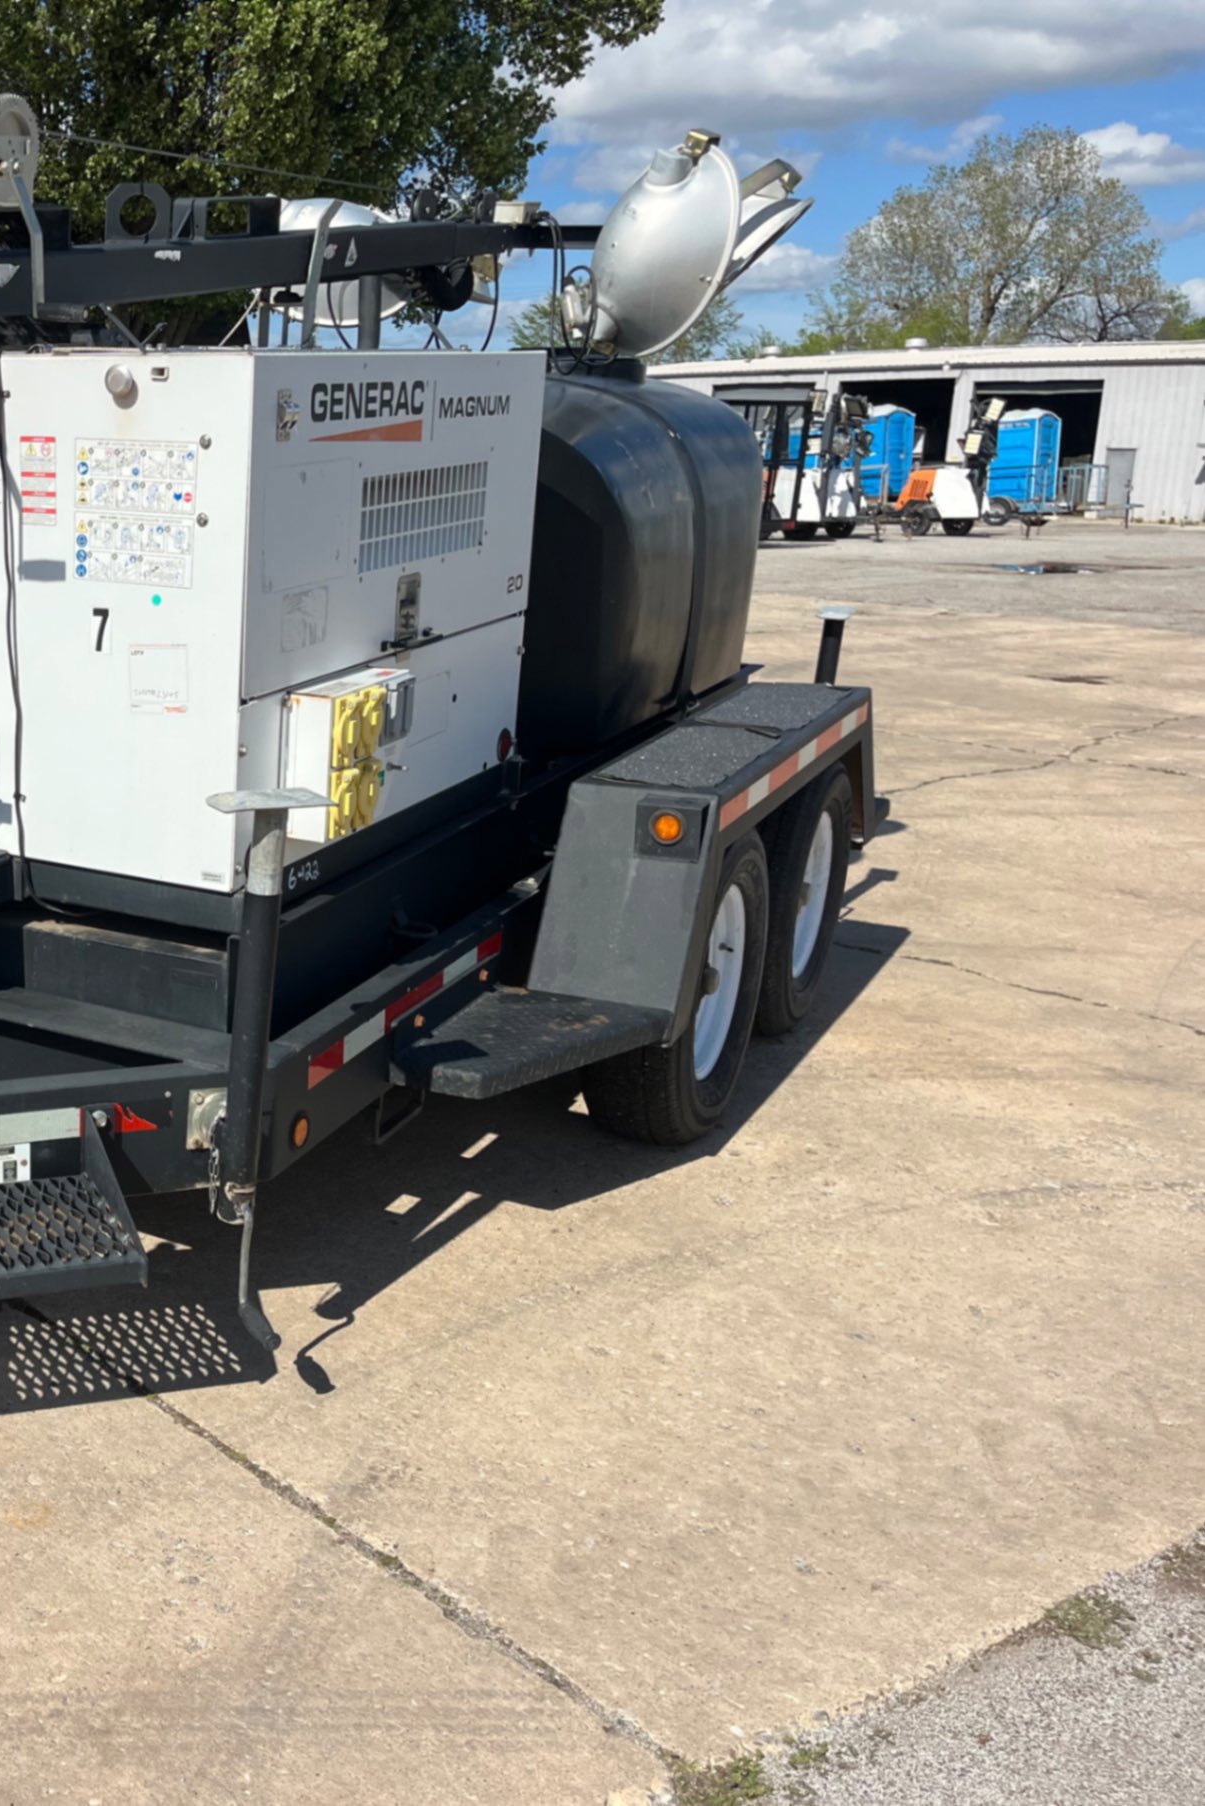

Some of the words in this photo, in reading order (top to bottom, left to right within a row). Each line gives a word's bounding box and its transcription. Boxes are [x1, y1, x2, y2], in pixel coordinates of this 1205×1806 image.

[311, 380, 425, 422] GENERAC
[439, 395, 510, 419] MAGNUM
[507, 574, 523, 594] 20
[93, 608, 109, 652] 7
